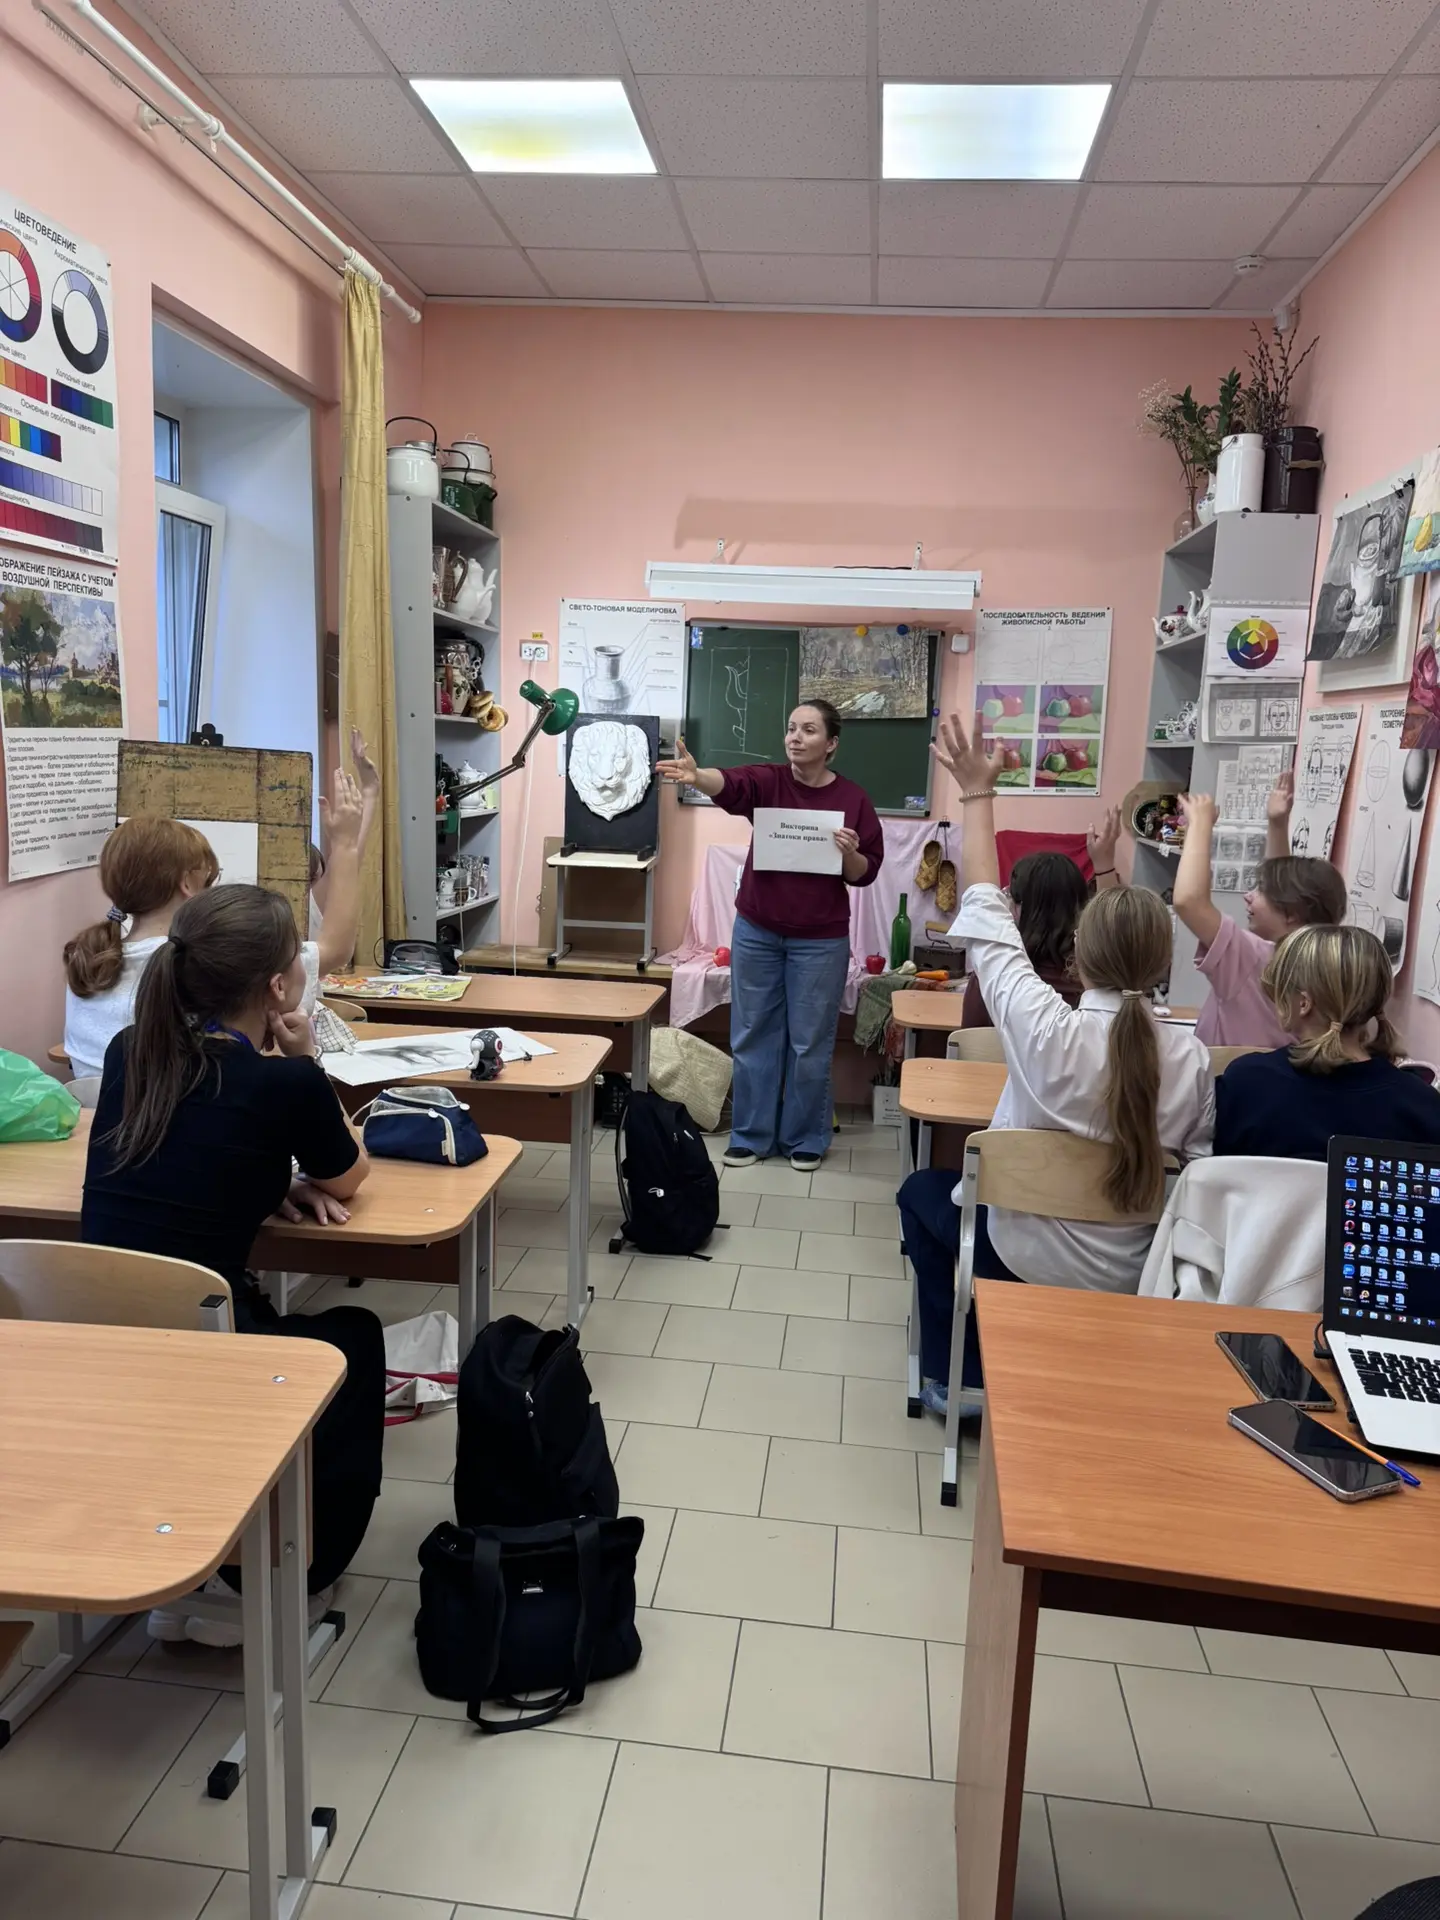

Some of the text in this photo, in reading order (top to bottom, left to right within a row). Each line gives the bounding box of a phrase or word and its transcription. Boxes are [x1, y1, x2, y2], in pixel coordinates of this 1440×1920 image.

[14, 208, 77, 254] ЦВЕТОВЕДЕНИЕ
[2, 571, 103, 597] ВОЗДУШНОЙ ПЕРСПЕКТИВЫ
[47, 565, 80, 581] ПЕЙЗАЖА
[82, 574, 87, 582] С
[88, 576, 114, 587] УЧЕТОМ
[569, 603, 677, 614] СВЕТО-ТОНОВАЯ МОДЕЛИРОВКА
[780, 822, 818, 831] Викторина
[769, 832, 801, 840] «Знатоки
